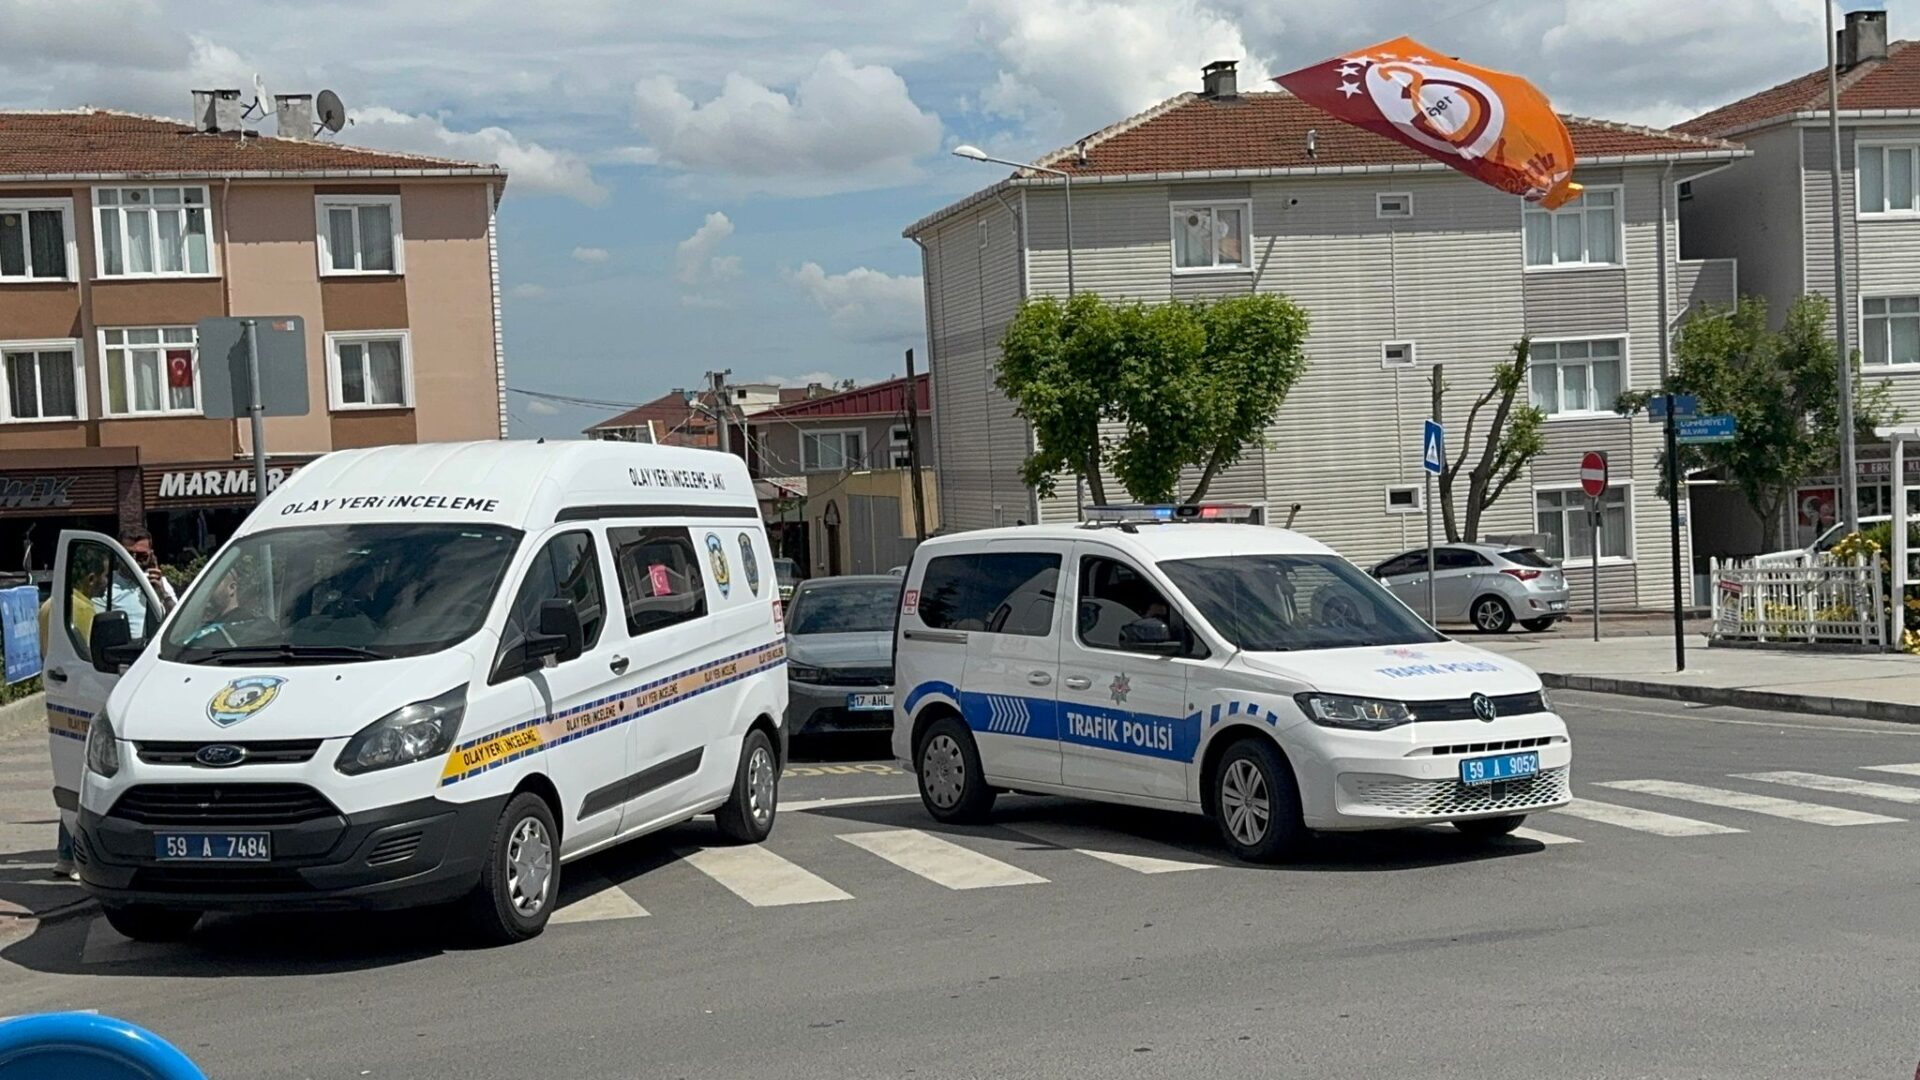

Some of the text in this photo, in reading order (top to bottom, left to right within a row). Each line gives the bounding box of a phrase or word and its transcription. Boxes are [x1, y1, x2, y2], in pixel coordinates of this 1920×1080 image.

[158, 467, 300, 498] MARMR
[629, 467, 652, 487] OLAY
[281, 499, 336, 516] OLAY
[855, 694, 890, 706] 17 AHL
[1066, 712, 1173, 751] TRAFİK POLİSİ
[463, 747, 484, 766] OLAY
[1469, 755, 1536, 779] 59 A 9052
[167, 836, 267, 858] 59 A 7484
